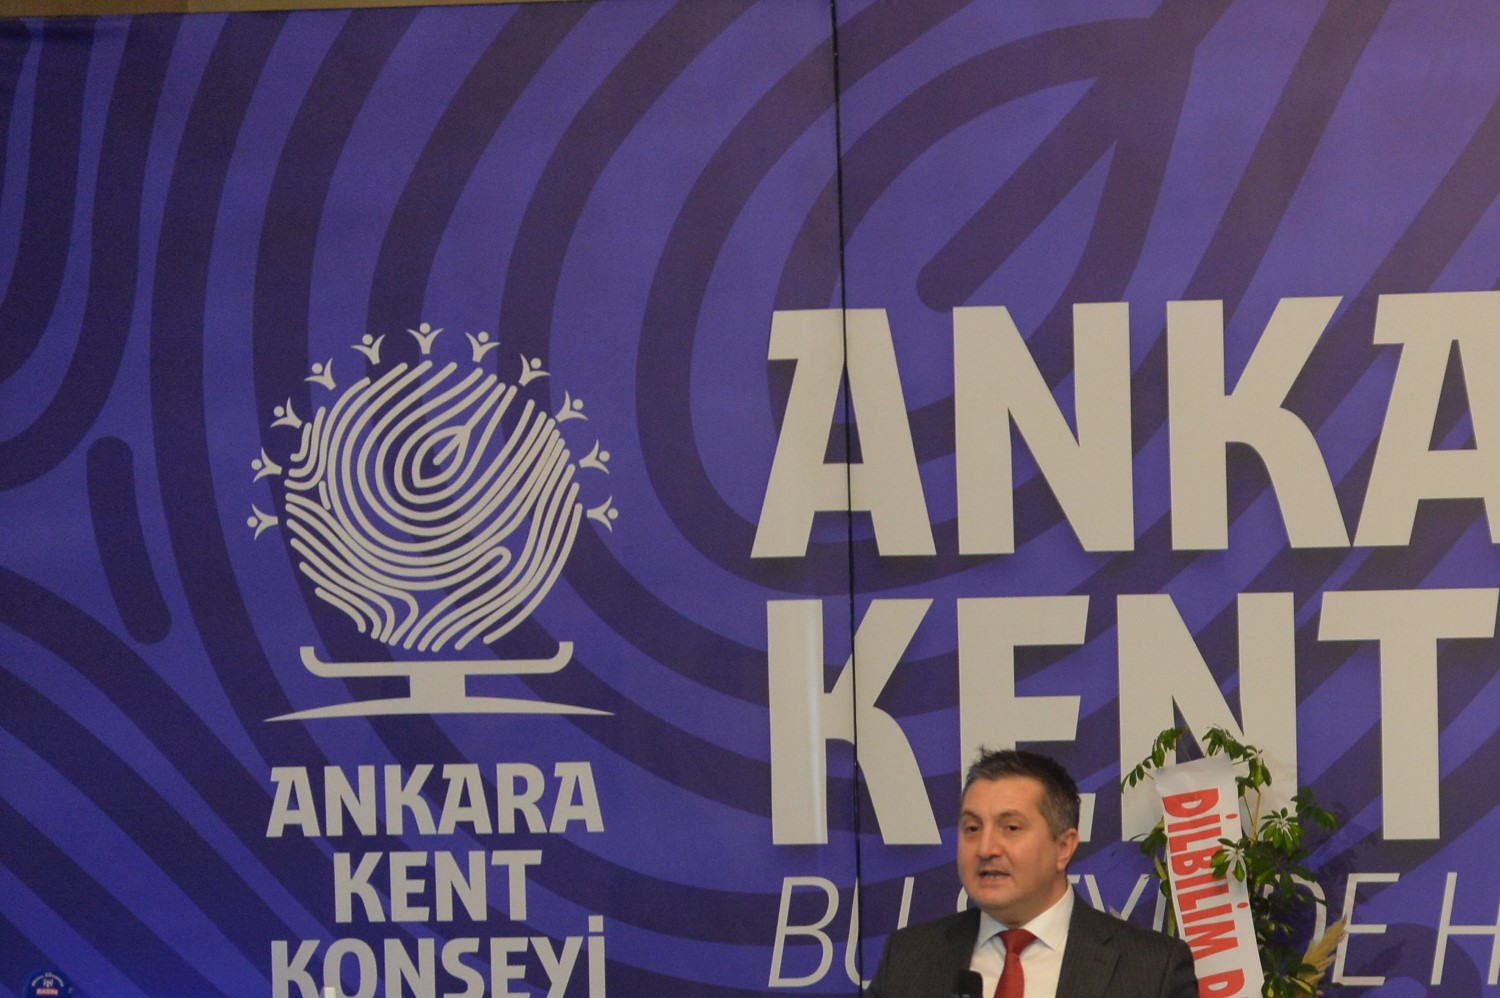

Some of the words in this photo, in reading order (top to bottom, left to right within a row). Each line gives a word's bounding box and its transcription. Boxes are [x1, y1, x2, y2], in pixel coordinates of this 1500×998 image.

[766, 587, 1500, 847] KENT
[266, 761, 605, 838] ANKARA
[333, 850, 543, 924] KENT
